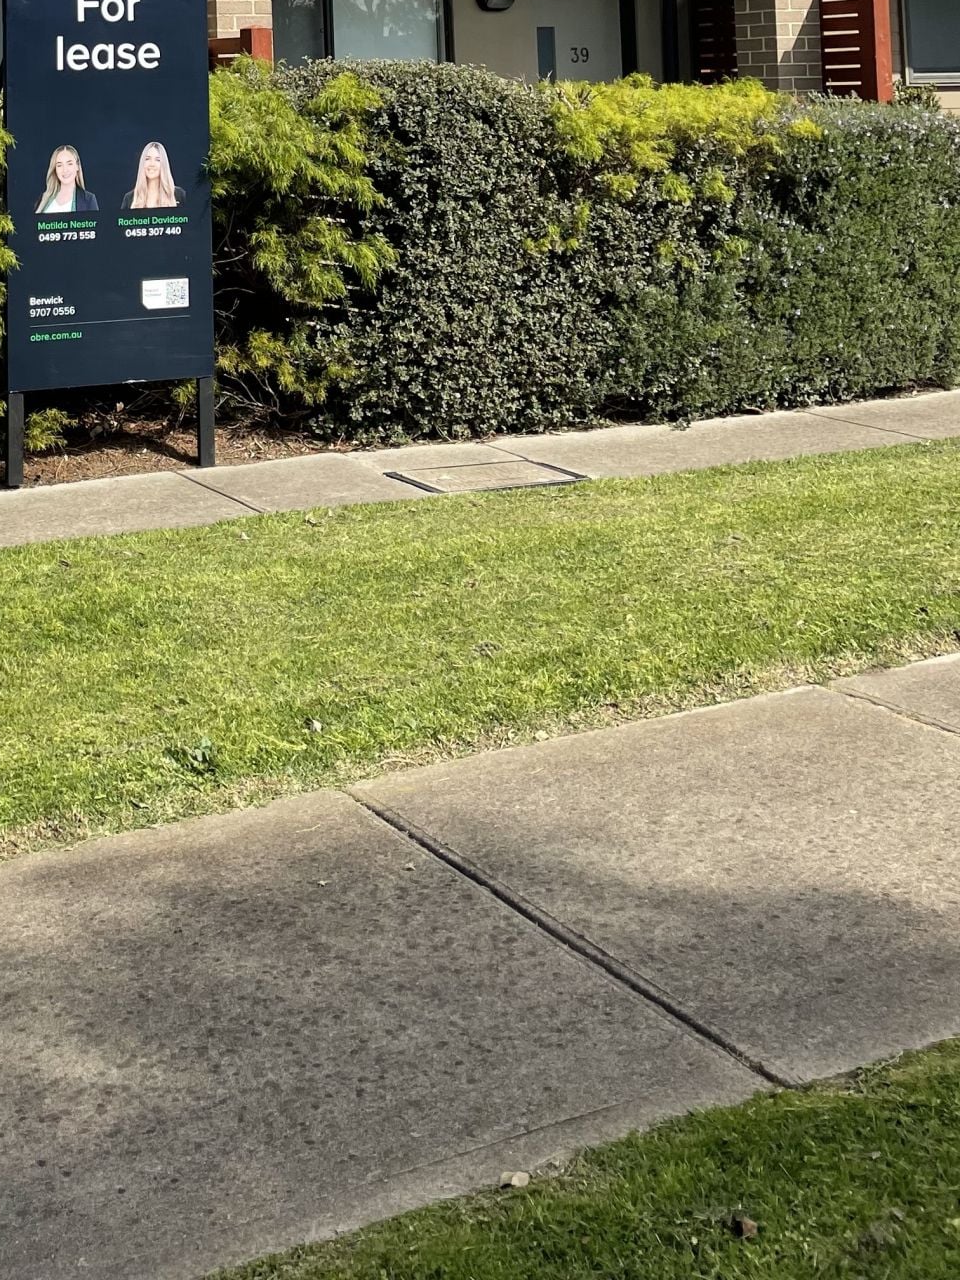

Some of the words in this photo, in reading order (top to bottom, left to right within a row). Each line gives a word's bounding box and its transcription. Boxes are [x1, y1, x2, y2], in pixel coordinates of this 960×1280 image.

[56, 35, 161, 70] lease
[570, 47, 589, 63] 39
[37, 221, 68, 231] Matilda
[70, 220, 97, 229] Nestor
[118, 217, 150, 226] Rachael
[151, 216, 189, 224] Davidson
[38, 232, 61, 242] 0499
[62, 231, 78, 241] 773
[79, 230, 96, 240] 558
[125, 228, 147, 237] 0458
[148, 227, 164, 236] 307
[165, 226, 182, 235] 440
[29, 295, 64, 306] Berwick
[30, 307, 51, 318] 9707
[52, 305, 76, 317] 0556
[30, 331, 82, 342] obre.com.au
